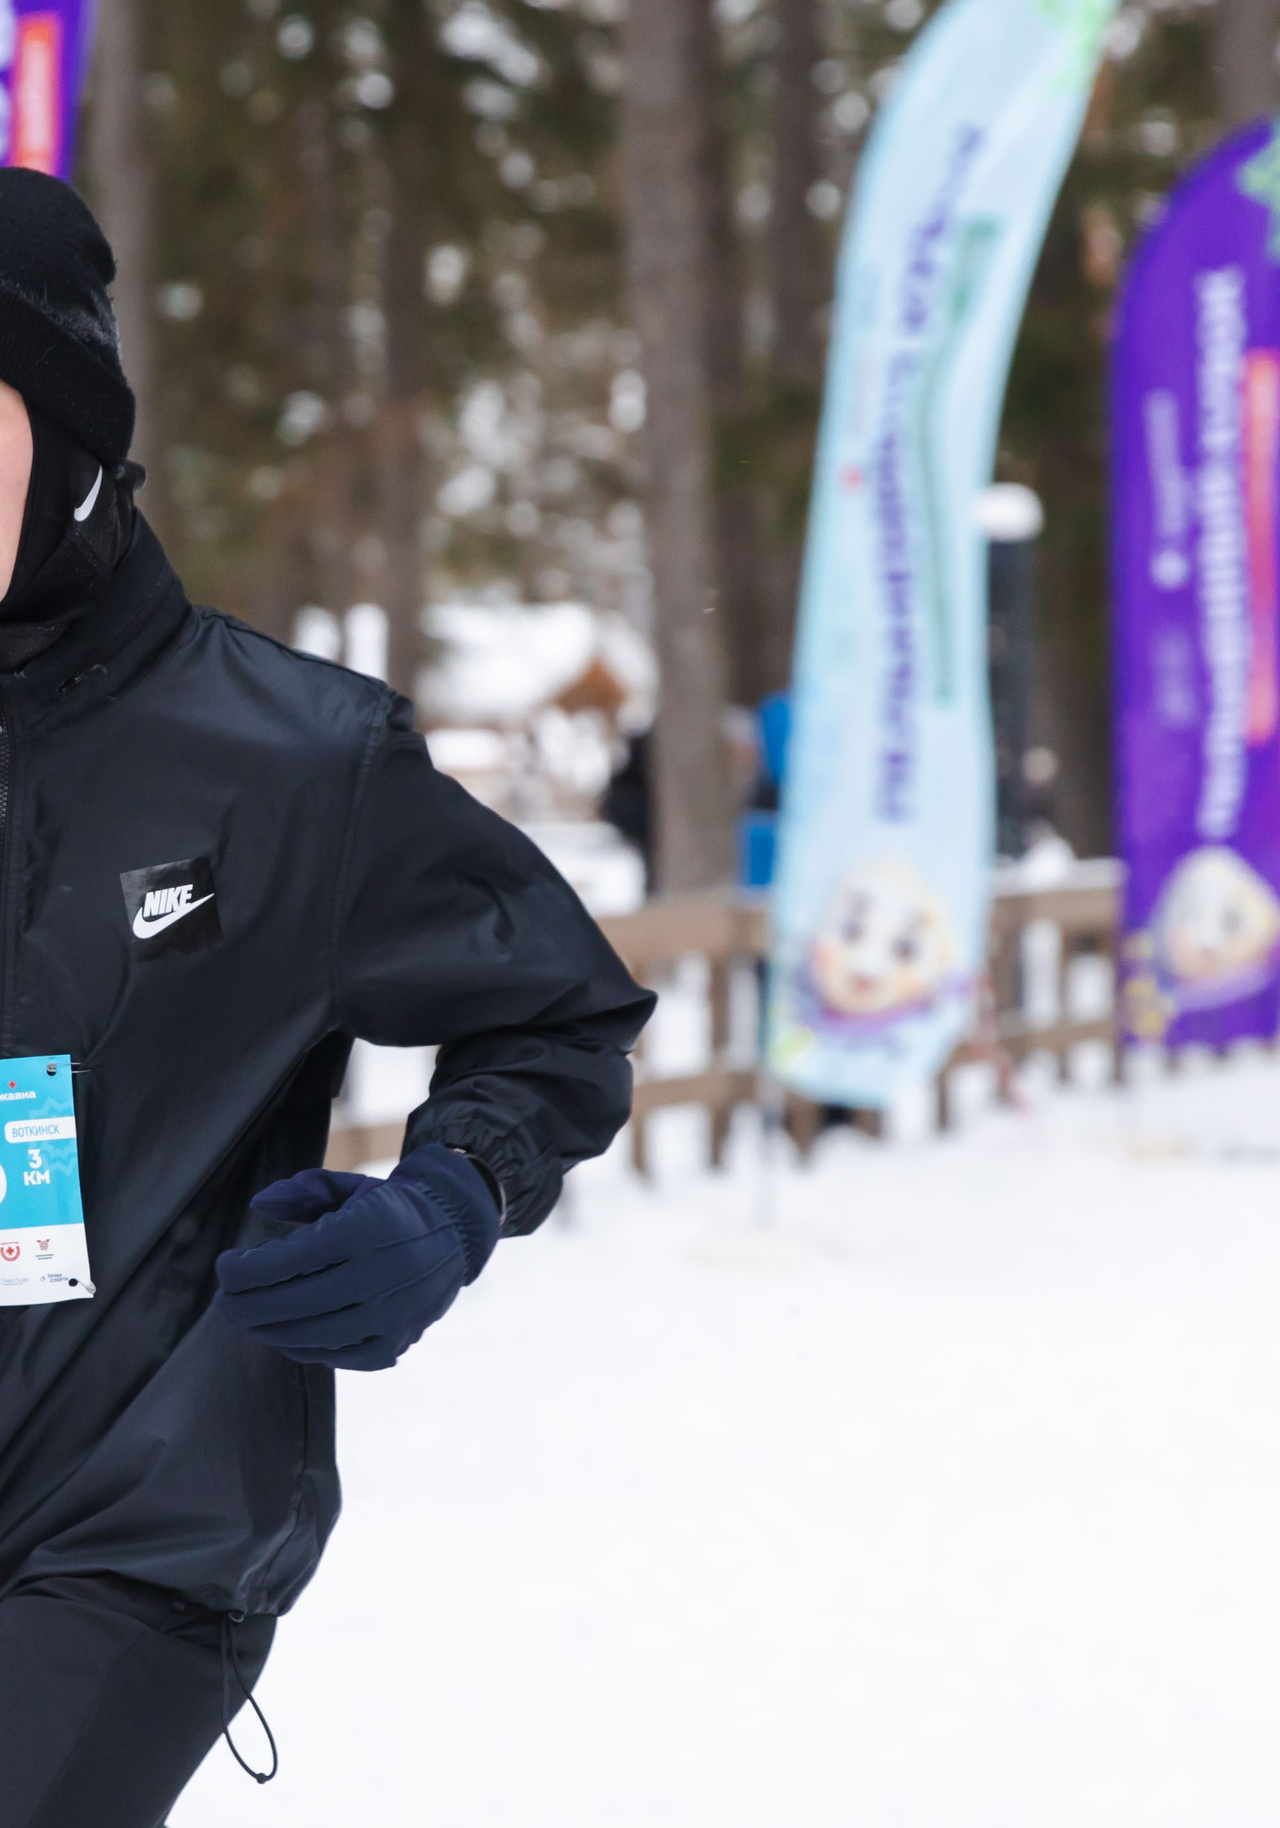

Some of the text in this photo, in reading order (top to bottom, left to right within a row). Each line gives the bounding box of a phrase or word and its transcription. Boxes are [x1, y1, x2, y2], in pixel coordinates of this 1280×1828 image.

[143, 884, 193, 918] NIKE
[12, 1125, 60, 1138] ВОТКИНСК
[28, 1149, 43, 1169] 3
[23, 1170, 51, 1186] КМ
